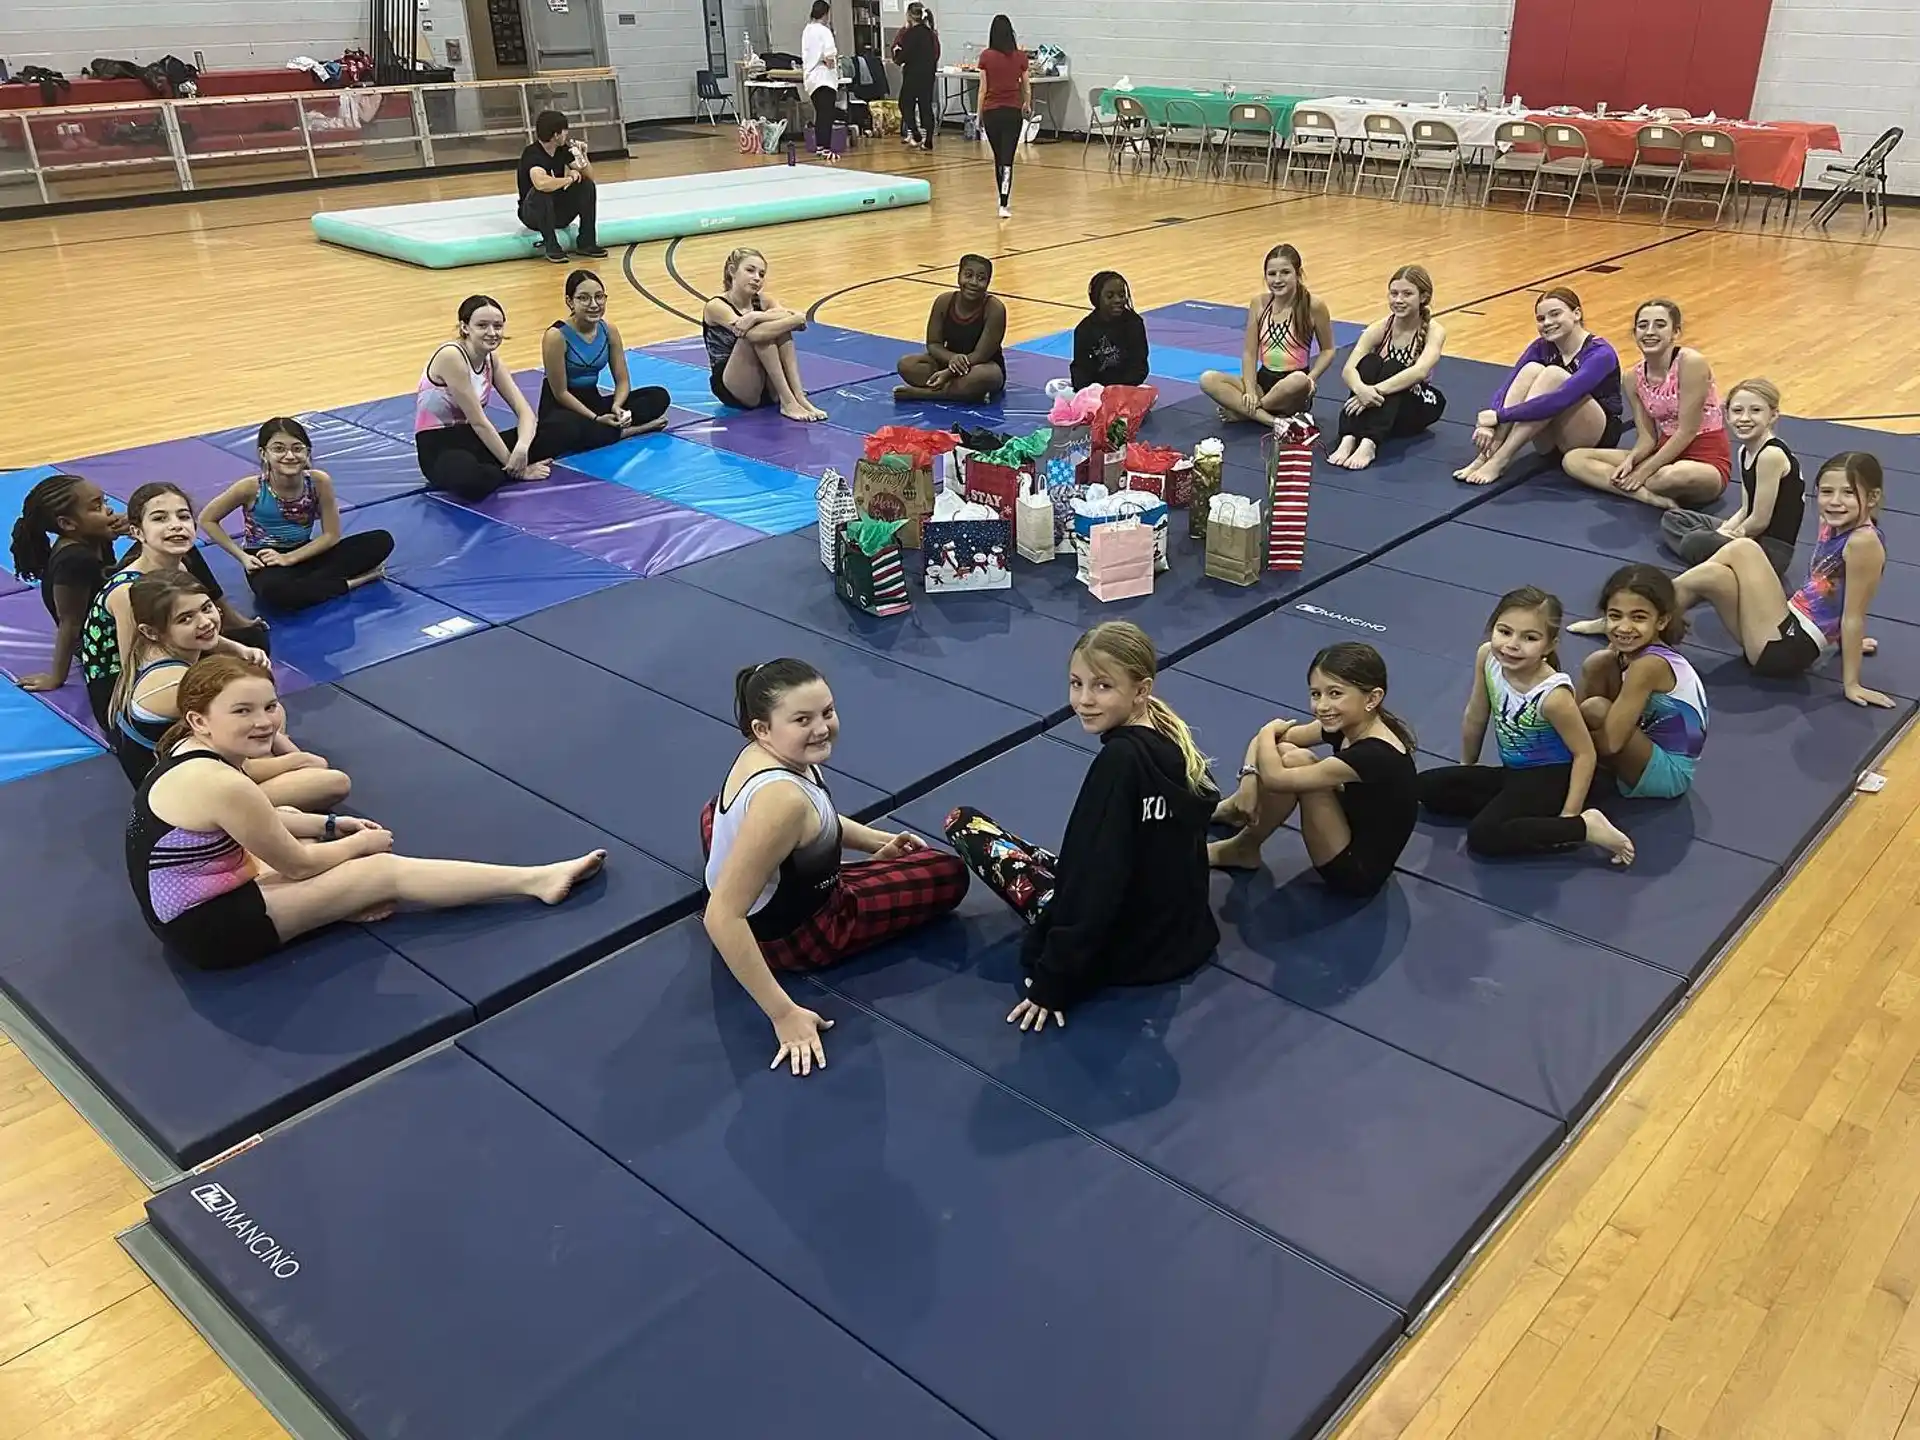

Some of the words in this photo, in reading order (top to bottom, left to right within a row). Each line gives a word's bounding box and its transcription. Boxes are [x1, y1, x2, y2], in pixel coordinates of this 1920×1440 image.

[970, 489, 1002, 508] STAY
[1320, 610, 1387, 632] MANCINO
[1142, 795, 1173, 822] KO
[216, 1205, 300, 1279] MANCINO
